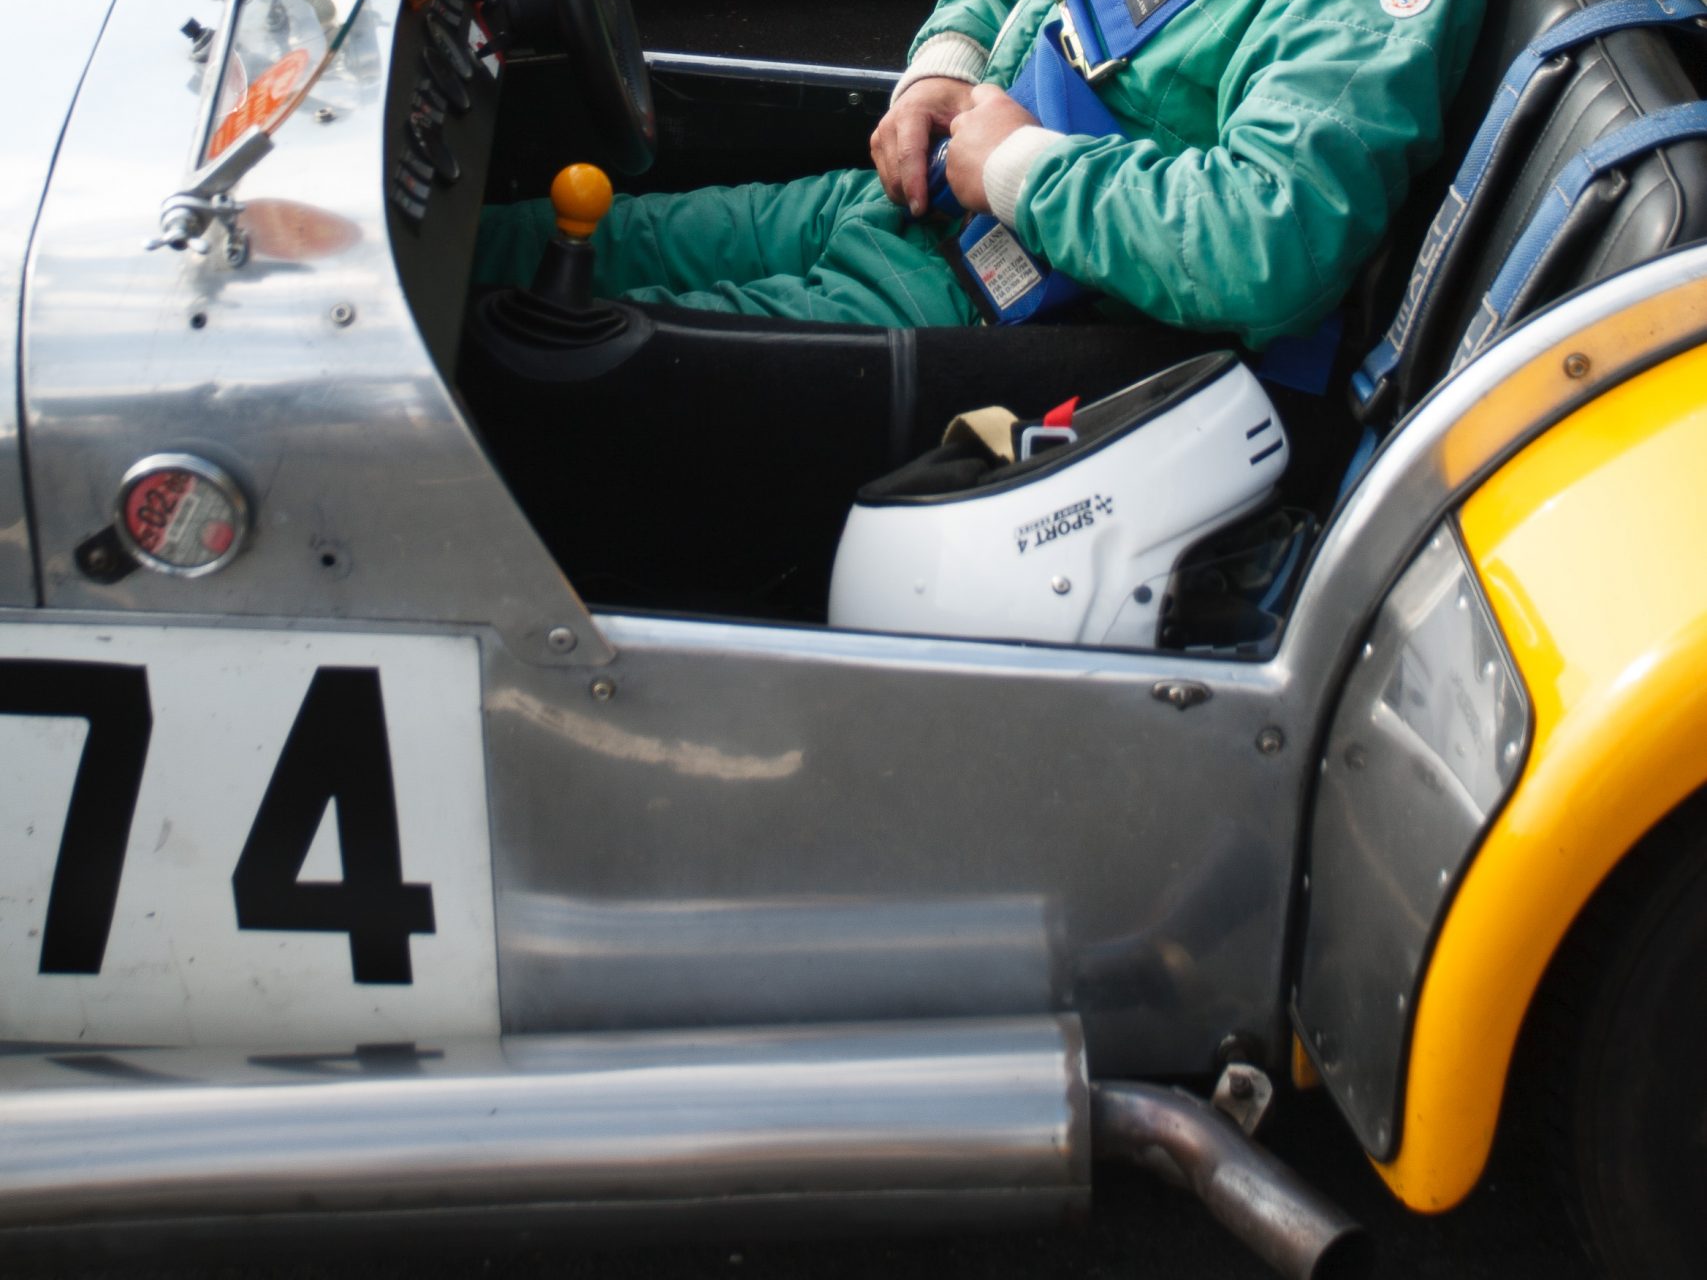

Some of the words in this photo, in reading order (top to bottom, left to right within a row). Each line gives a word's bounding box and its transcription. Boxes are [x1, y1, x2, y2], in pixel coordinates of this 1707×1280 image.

[968, 229, 1003, 261] WILLANS
[1017, 539, 1028, 554] 4
[1034, 510, 1095, 548] SPORT
[0, 657, 437, 985] 74
